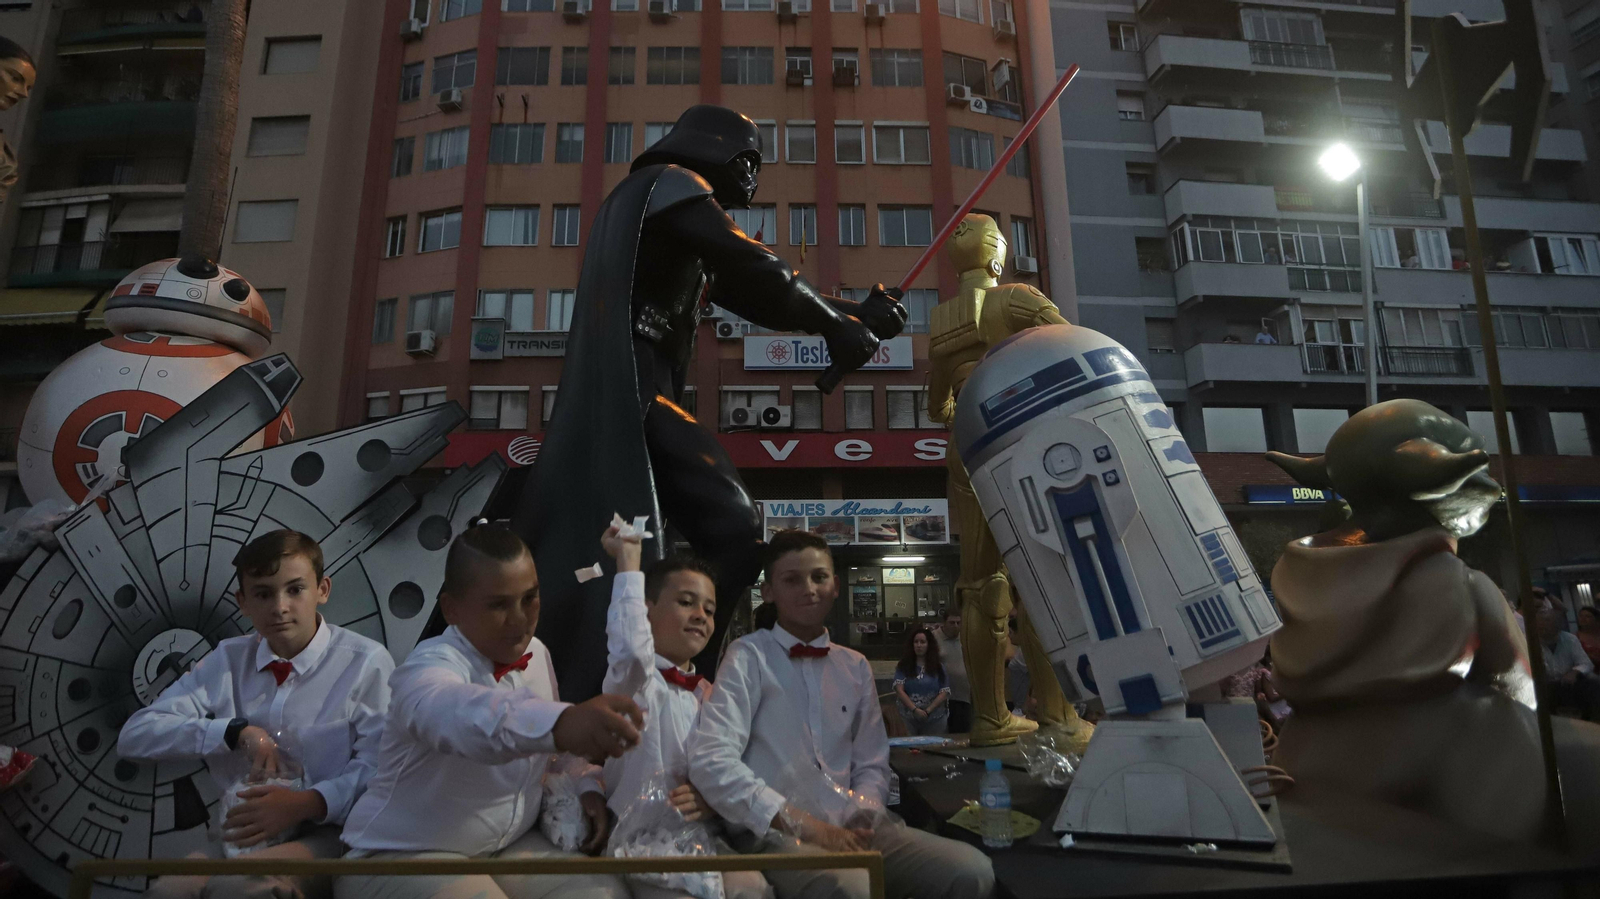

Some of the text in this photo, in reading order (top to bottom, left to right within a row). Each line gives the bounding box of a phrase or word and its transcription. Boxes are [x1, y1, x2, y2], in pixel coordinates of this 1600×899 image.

[507, 340, 567, 349] TRANSI
[1292, 487, 1325, 500] BBVA
[769, 503, 826, 516] VIAJES
